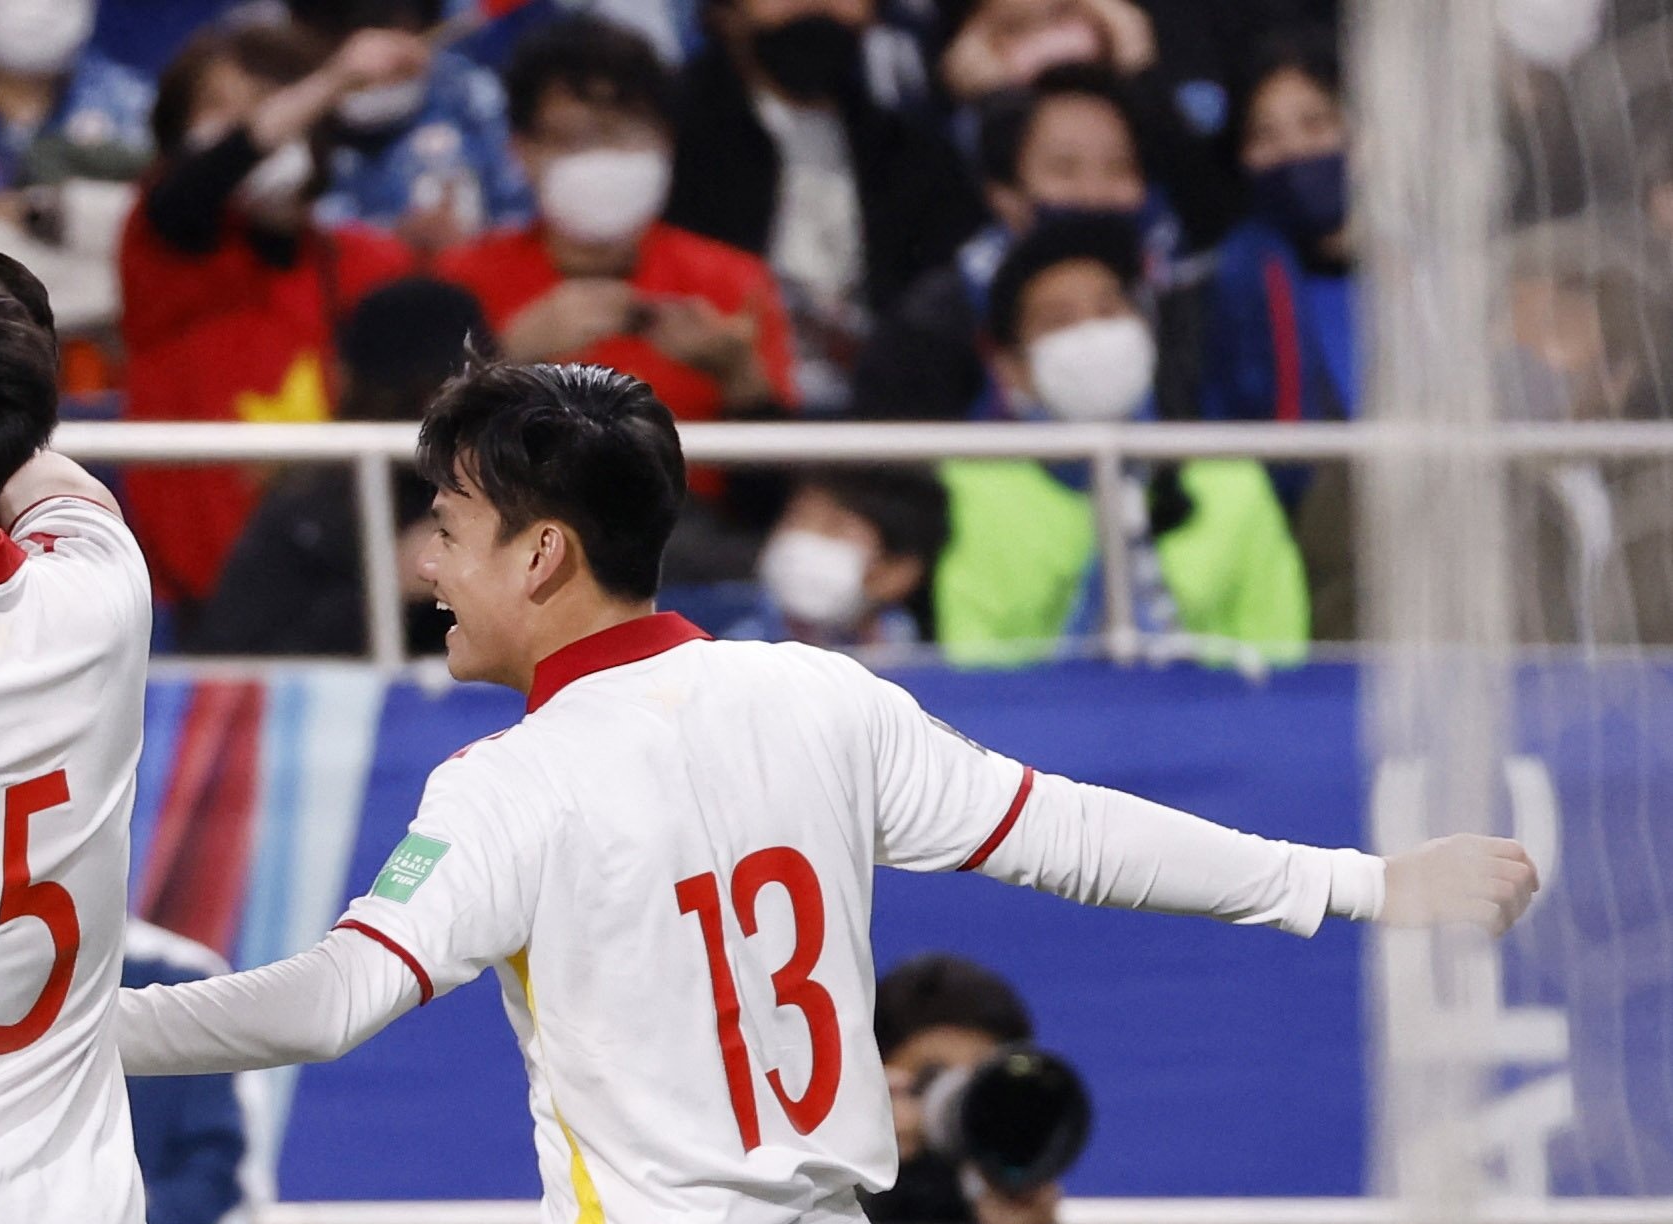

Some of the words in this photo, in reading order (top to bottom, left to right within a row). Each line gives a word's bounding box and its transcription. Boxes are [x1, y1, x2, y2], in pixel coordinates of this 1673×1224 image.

[395, 856, 426, 874] TBALL
[400, 850, 434, 866] ING
[391, 873, 417, 887] FIFA
[675, 846, 842, 1153] 13
